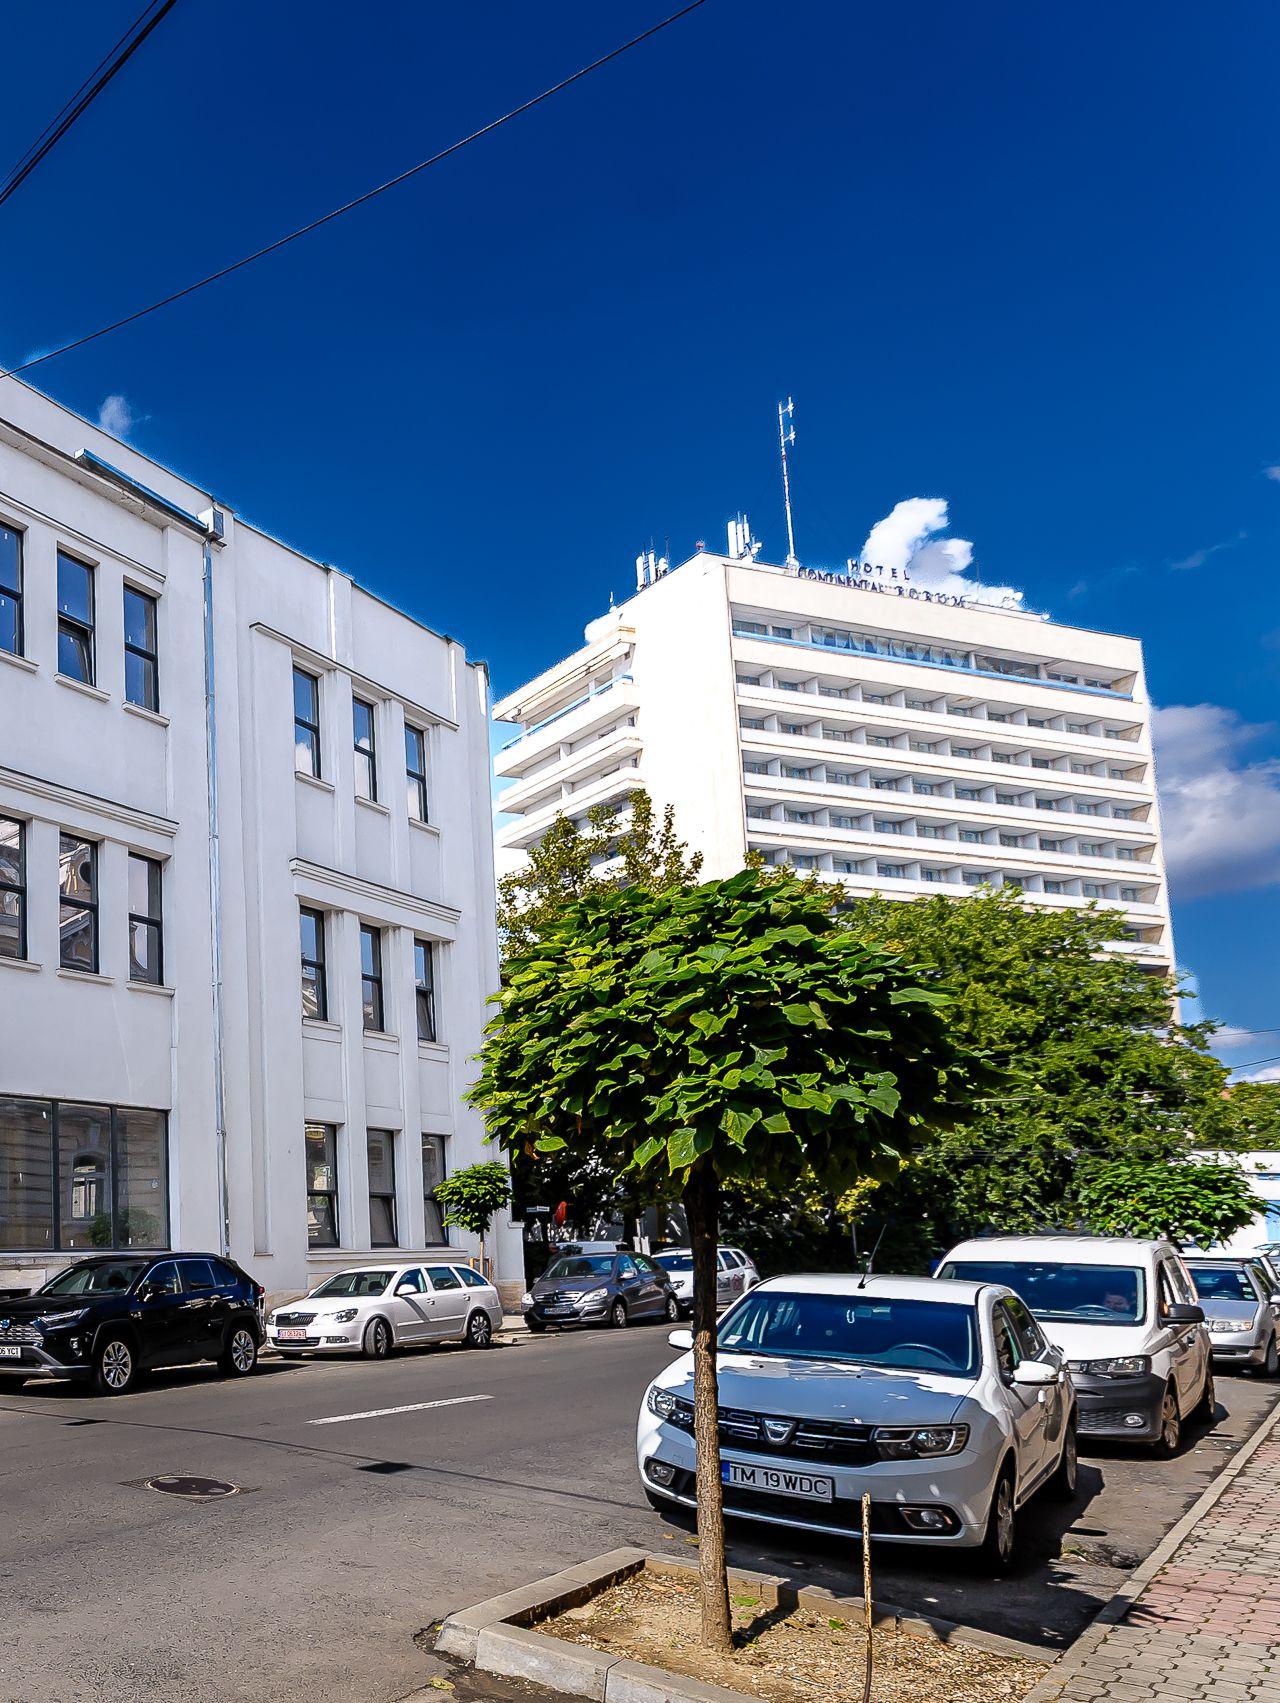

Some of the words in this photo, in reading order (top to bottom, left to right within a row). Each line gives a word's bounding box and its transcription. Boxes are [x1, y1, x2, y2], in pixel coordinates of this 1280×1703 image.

[797, 566, 885, 593] CONTINENTAL
[851, 560, 911, 581] HOTEL
[730, 1464, 756, 1484] TM
[763, 1470, 781, 1488] 19
[782, 1474, 828, 1495] WDC
